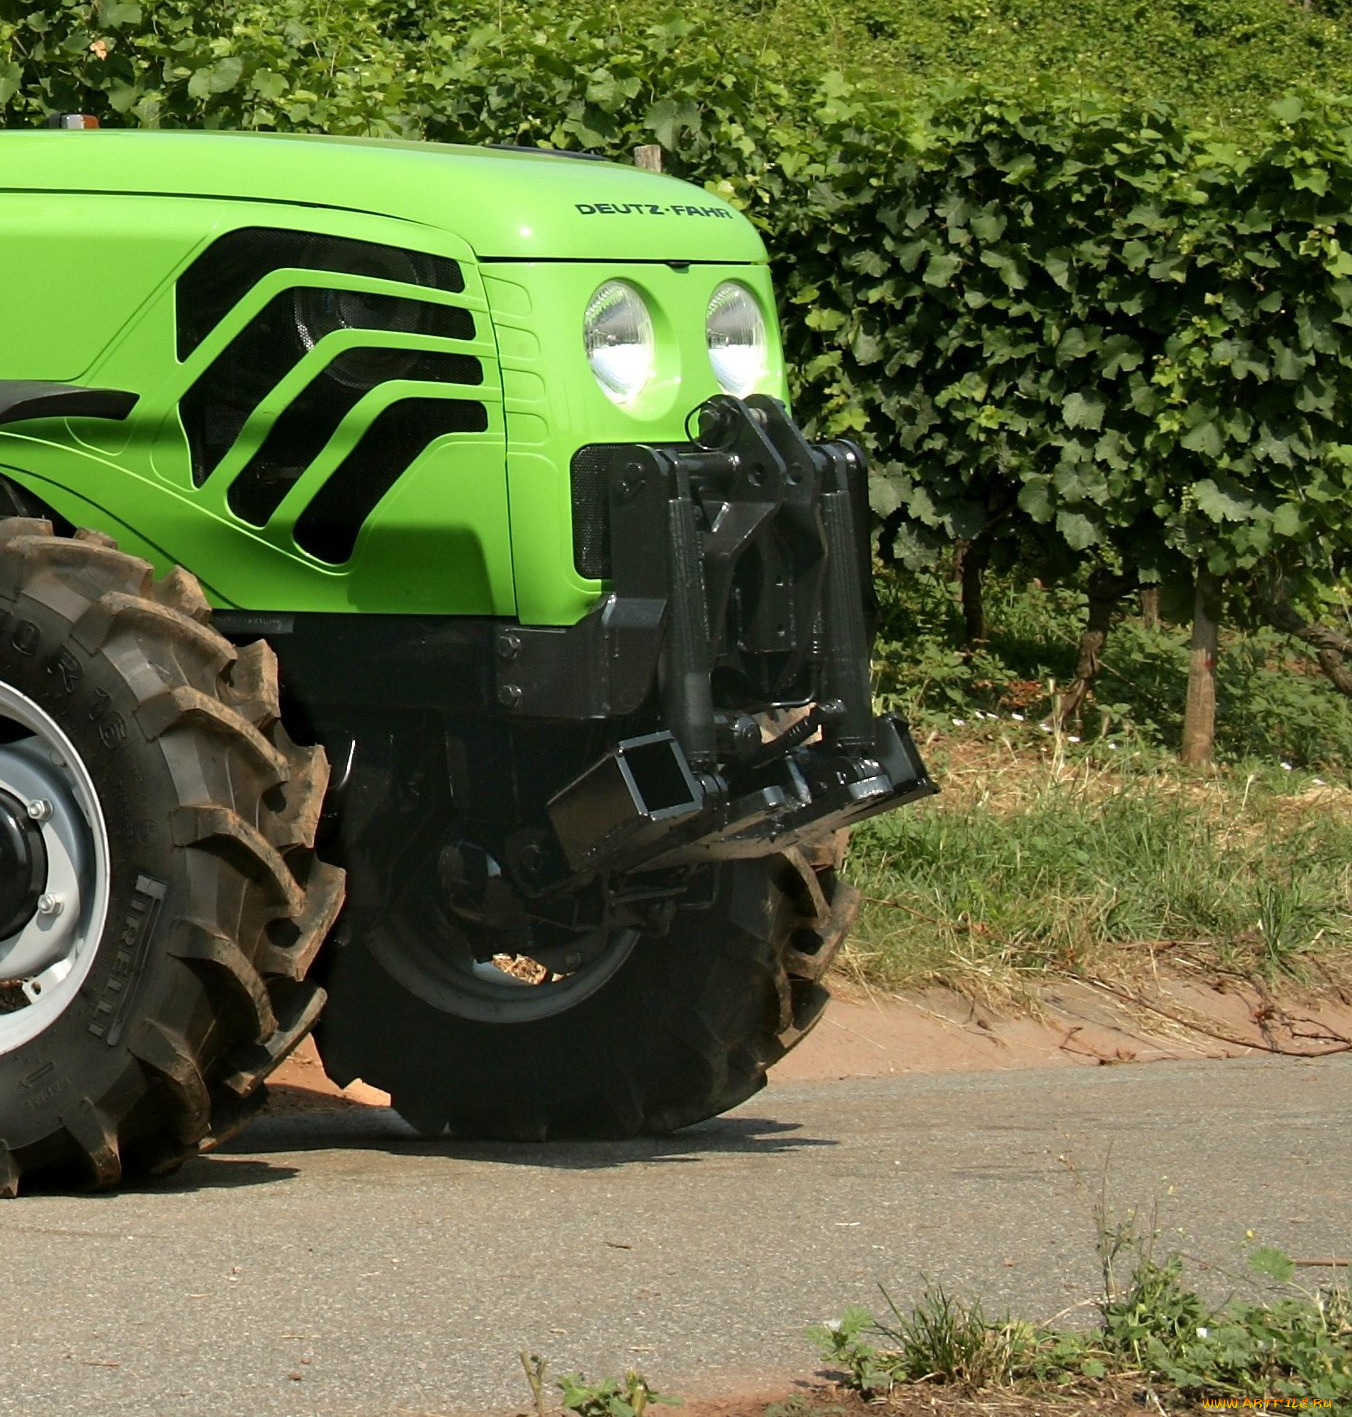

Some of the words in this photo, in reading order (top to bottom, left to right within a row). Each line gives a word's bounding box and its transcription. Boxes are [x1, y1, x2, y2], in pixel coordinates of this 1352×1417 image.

[47, 646, 85, 693] R
[87, 686, 131, 751] 16
[87, 874, 169, 1048] PIRELLI
